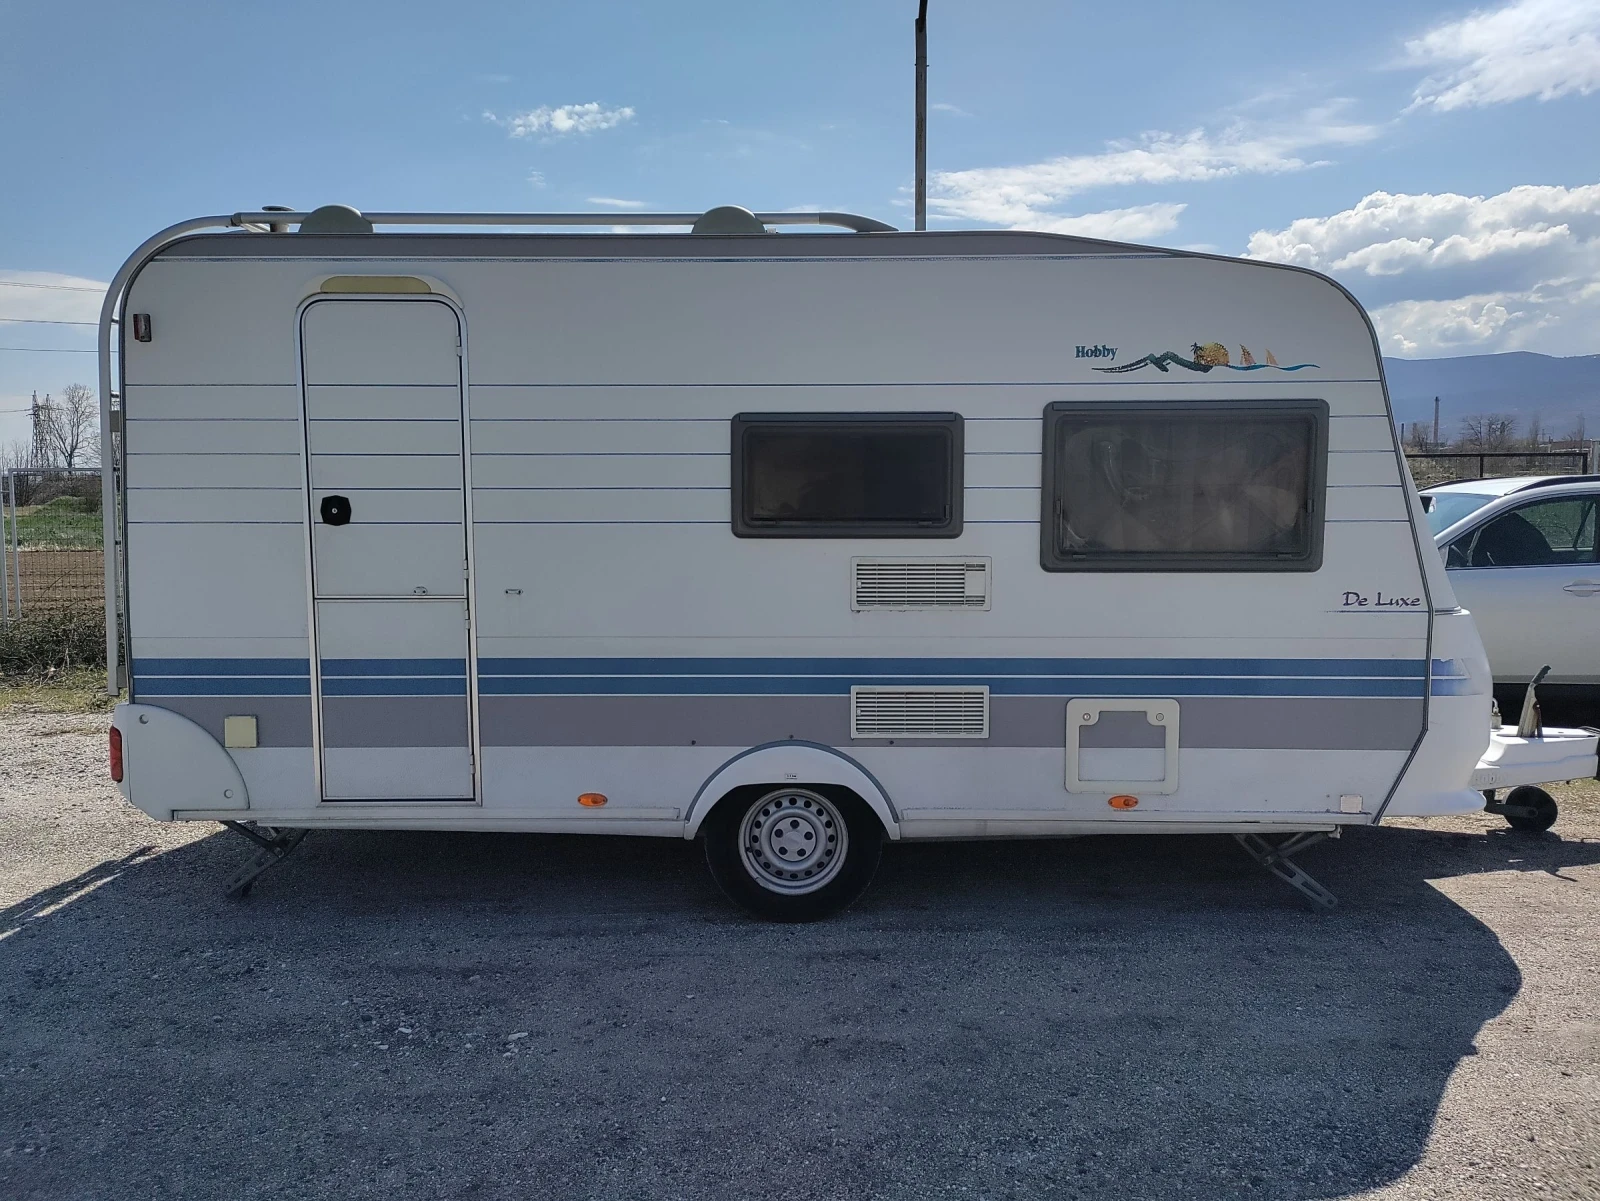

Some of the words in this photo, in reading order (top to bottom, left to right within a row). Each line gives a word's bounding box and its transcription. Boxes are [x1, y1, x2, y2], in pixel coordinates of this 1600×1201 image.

[1075, 344, 1119, 361] Hobby
[1342, 591, 1369, 606] De
[1374, 591, 1421, 608] Luxe
